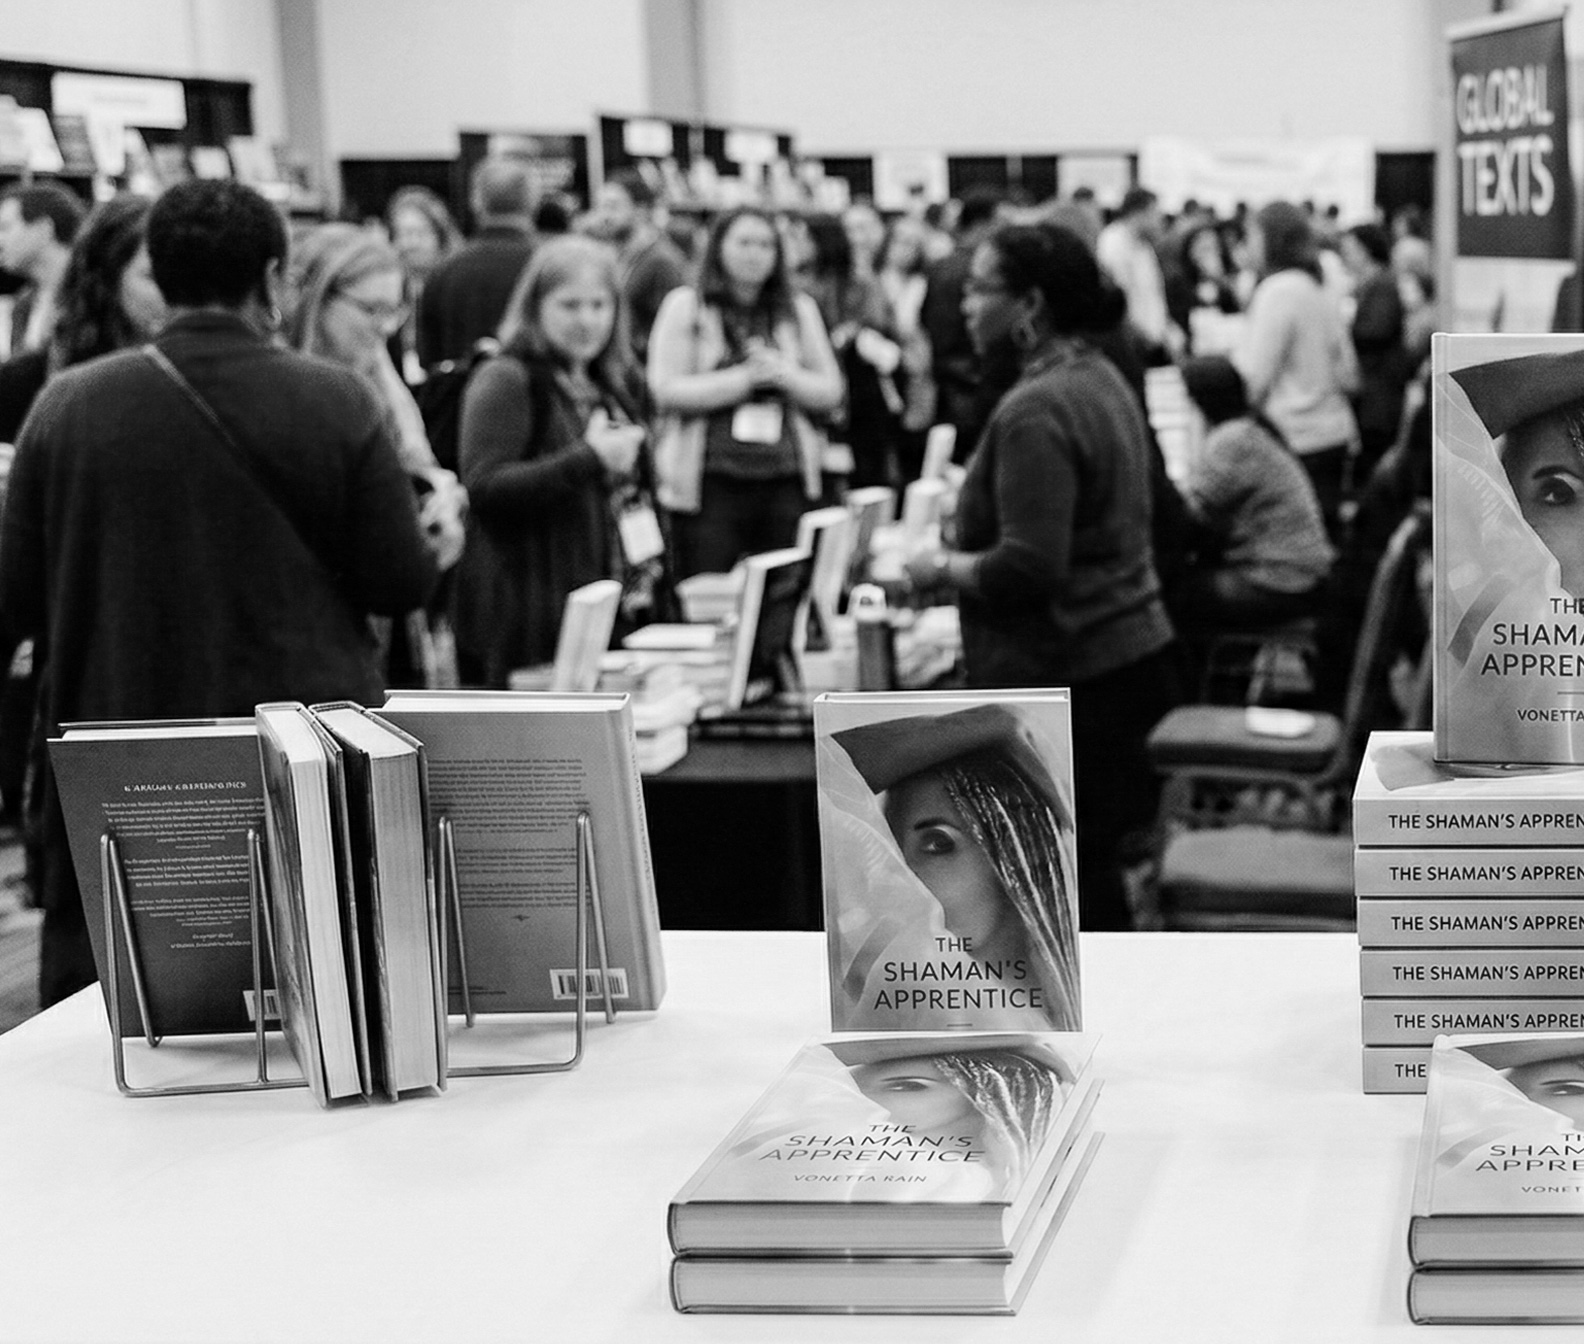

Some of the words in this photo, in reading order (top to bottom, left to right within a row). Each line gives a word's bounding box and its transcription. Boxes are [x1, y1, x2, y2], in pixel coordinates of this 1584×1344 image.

[1456, 65, 1555, 134] GLOBAL
[1456, 134, 1554, 216] TEXTS
[1388, 815, 1421, 829] THE
[1426, 814, 1515, 829] SHAMAN'S
[1389, 867, 1422, 881] THE
[1427, 866, 1516, 881] SHAMAN'S
[1391, 916, 1424, 931] THE
[1429, 915, 1519, 930] SHAMAN'S
[936, 938, 972, 952] THE
[884, 960, 1026, 981] SHAMAN'S
[1392, 966, 1425, 980] THE
[1430, 965, 1521, 981] SHAMAN'S
[874, 988, 1042, 1010] APPRENTICE
[1394, 1014, 1426, 1028] THE
[1431, 1014, 1522, 1028] SHAMAN'S
[1394, 1064, 1427, 1078] THE
[869, 1125, 917, 1133] THE
[785, 1135, 974, 1147] SHAMAN'S
[758, 1149, 985, 1162] APPRENTICE
